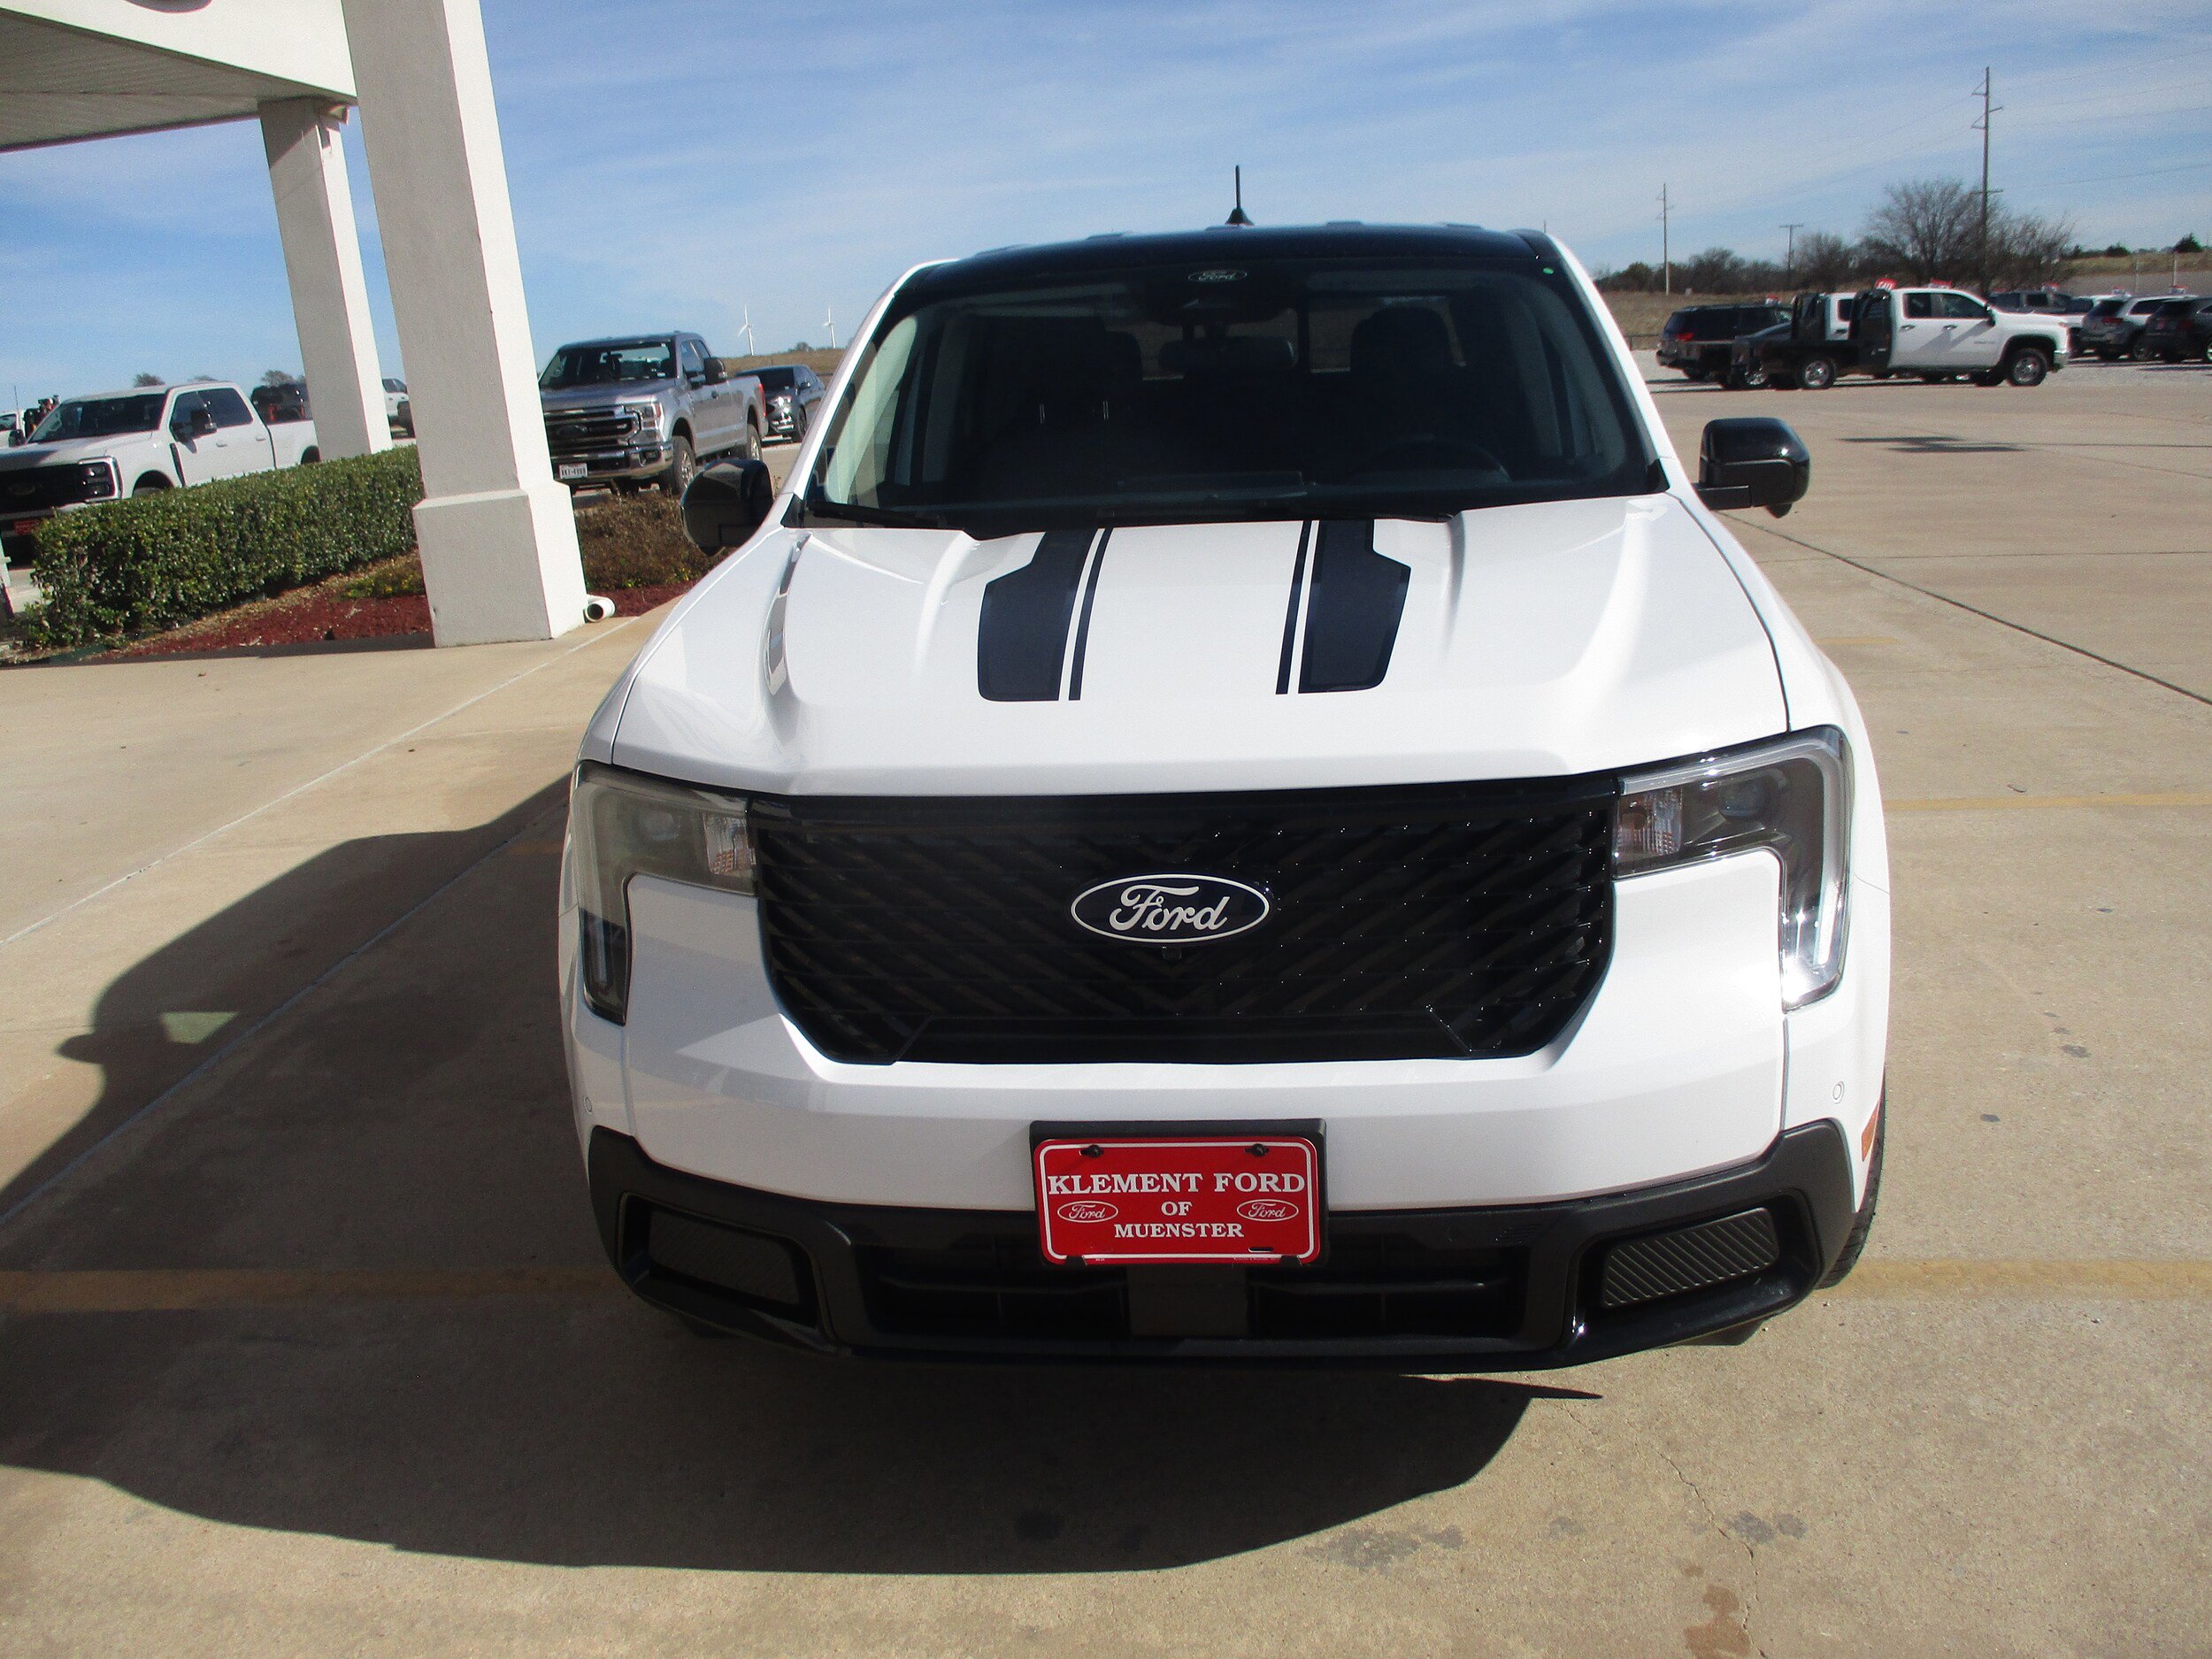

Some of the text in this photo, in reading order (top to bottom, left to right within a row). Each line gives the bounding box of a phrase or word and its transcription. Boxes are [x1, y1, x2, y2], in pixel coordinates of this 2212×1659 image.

[1109, 884, 1231, 931] Ford
[1047, 1172, 1306, 1194] KLEMENT FORD
[1068, 1203, 1107, 1220] Ford
[1161, 1201, 1193, 1217] OF
[1247, 1202, 1286, 1218] Ford
[1113, 1223, 1245, 1239] MUENSTER
